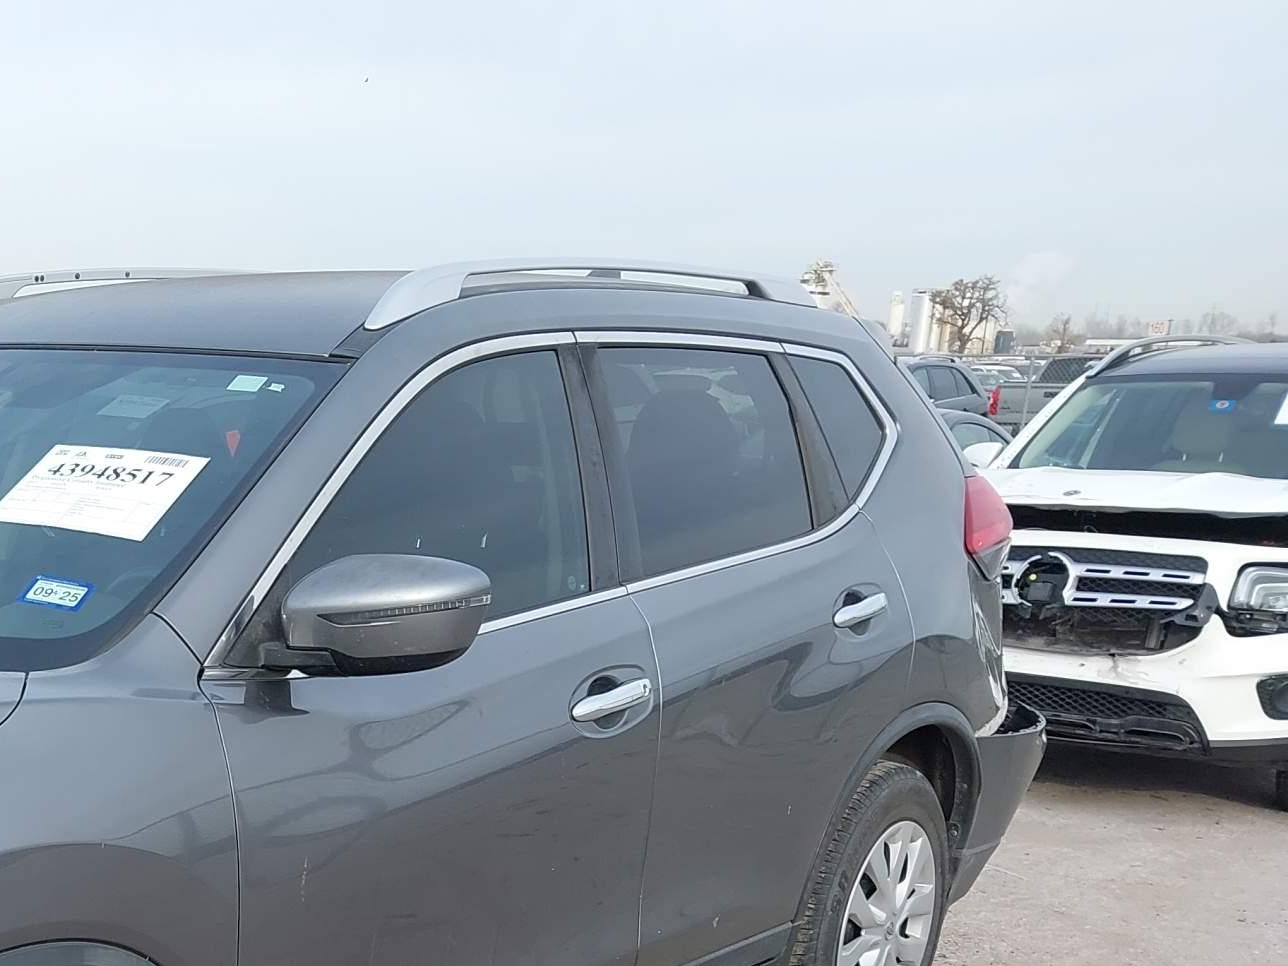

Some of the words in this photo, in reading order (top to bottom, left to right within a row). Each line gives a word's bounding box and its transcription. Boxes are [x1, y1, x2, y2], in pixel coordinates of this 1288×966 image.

[48, 463, 174, 487] 43948517
[33, 587, 53, 598] 09
[59, 591, 81, 602] 25
